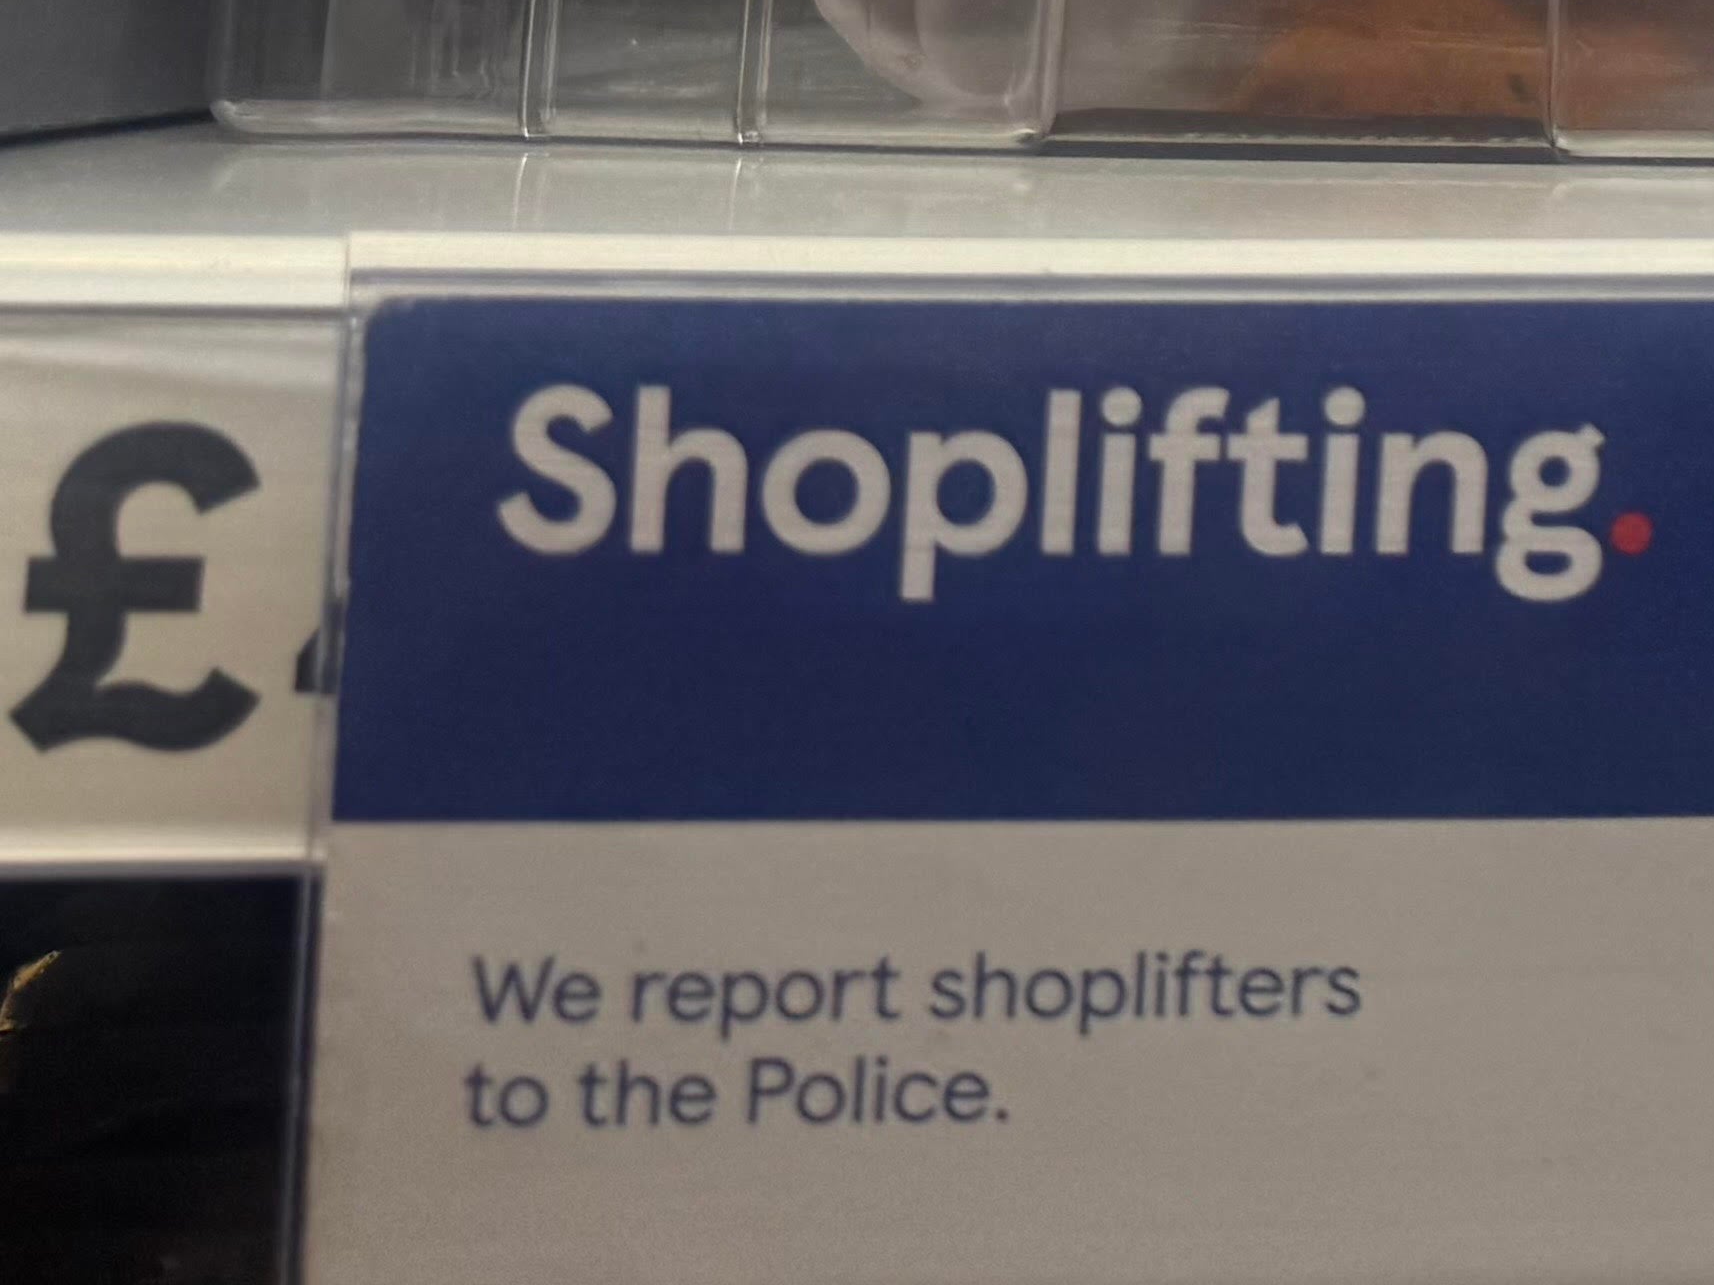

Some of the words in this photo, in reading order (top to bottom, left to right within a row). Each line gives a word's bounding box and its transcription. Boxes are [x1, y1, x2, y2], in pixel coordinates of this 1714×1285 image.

[498, 384, 1653, 602] Shoplifting.
[473, 954, 600, 1023] We
[632, 956, 900, 1040] report
[928, 948, 1361, 1036] shoplifters
[464, 1063, 549, 1130] to
[579, 1057, 717, 1127] the
[746, 1054, 1009, 1127] Police.
